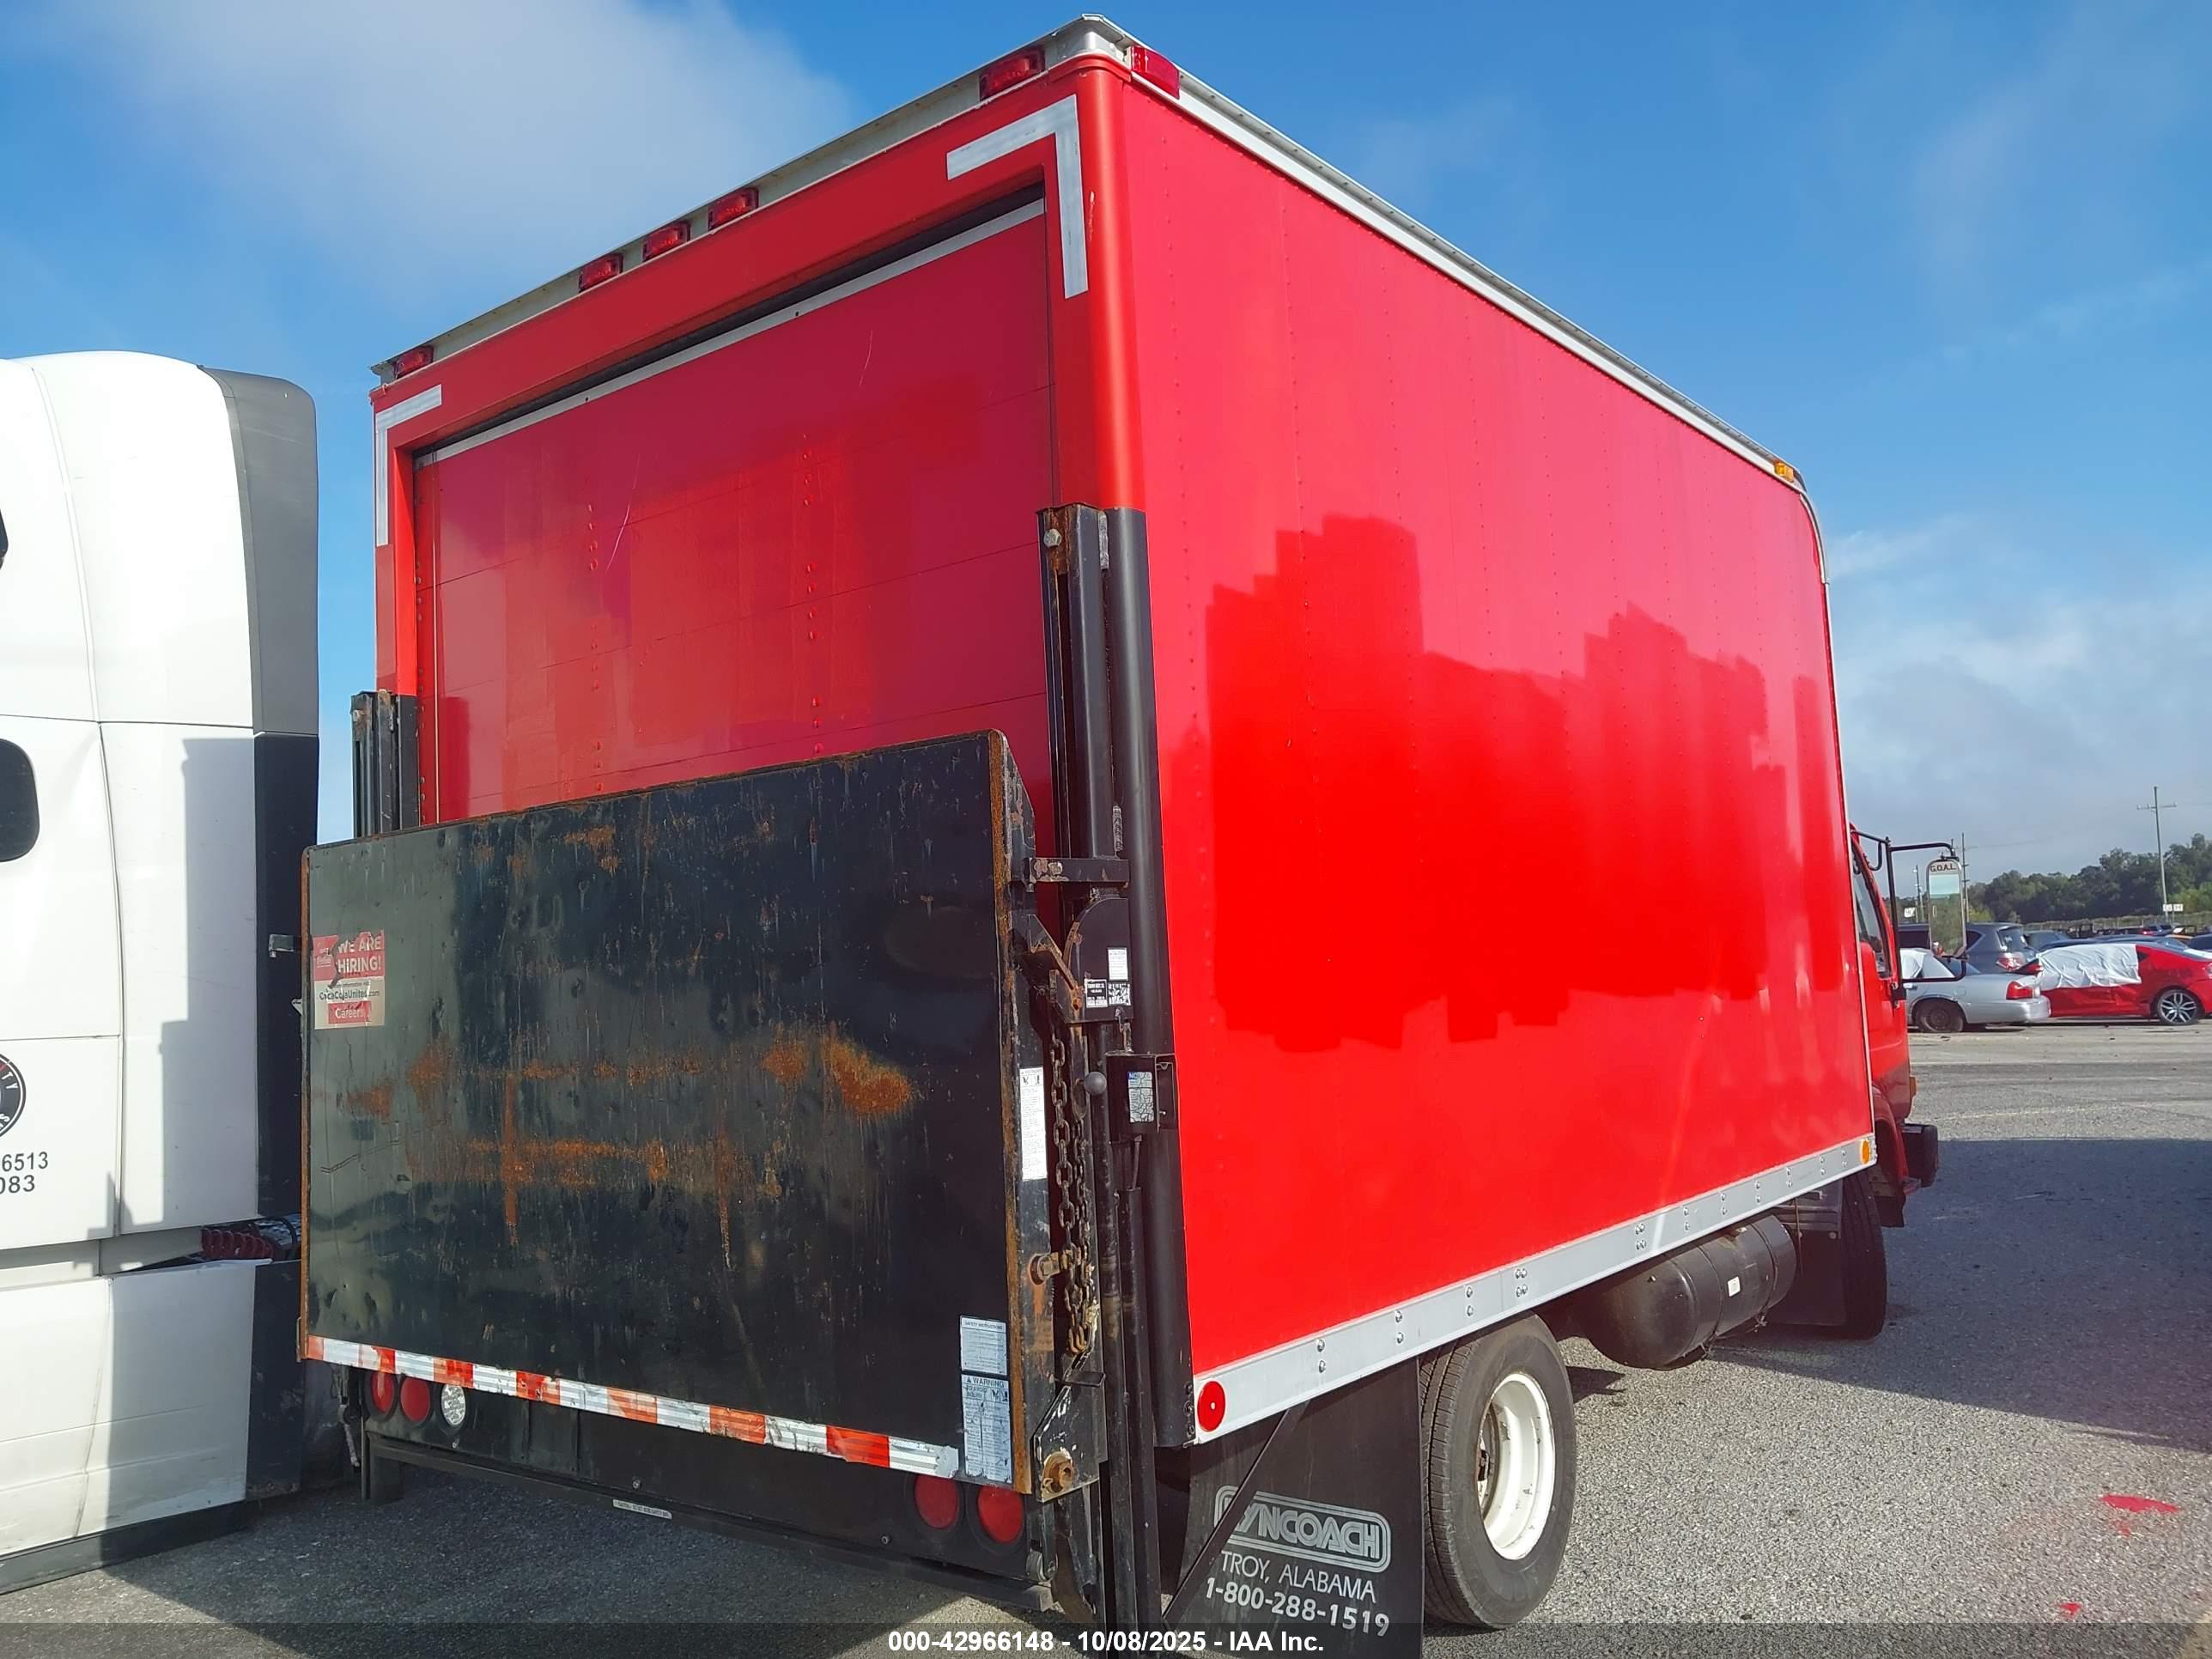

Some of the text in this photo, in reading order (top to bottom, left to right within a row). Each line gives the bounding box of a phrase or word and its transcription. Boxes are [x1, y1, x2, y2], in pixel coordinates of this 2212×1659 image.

[1930, 863, 1957, 872] GOAL
[359, 935, 382, 951] ARE
[337, 955, 381, 973] HIRING!
[2, 1152, 48, 1172] 6513
[973, 1377, 1004, 1388] WARNING
[1224, 1497, 1381, 1559] YNCOACH
[1221, 1550, 1377, 1603] TROY, ALABAMA
[1206, 1577, 1390, 1637] 1-800-288-1519
